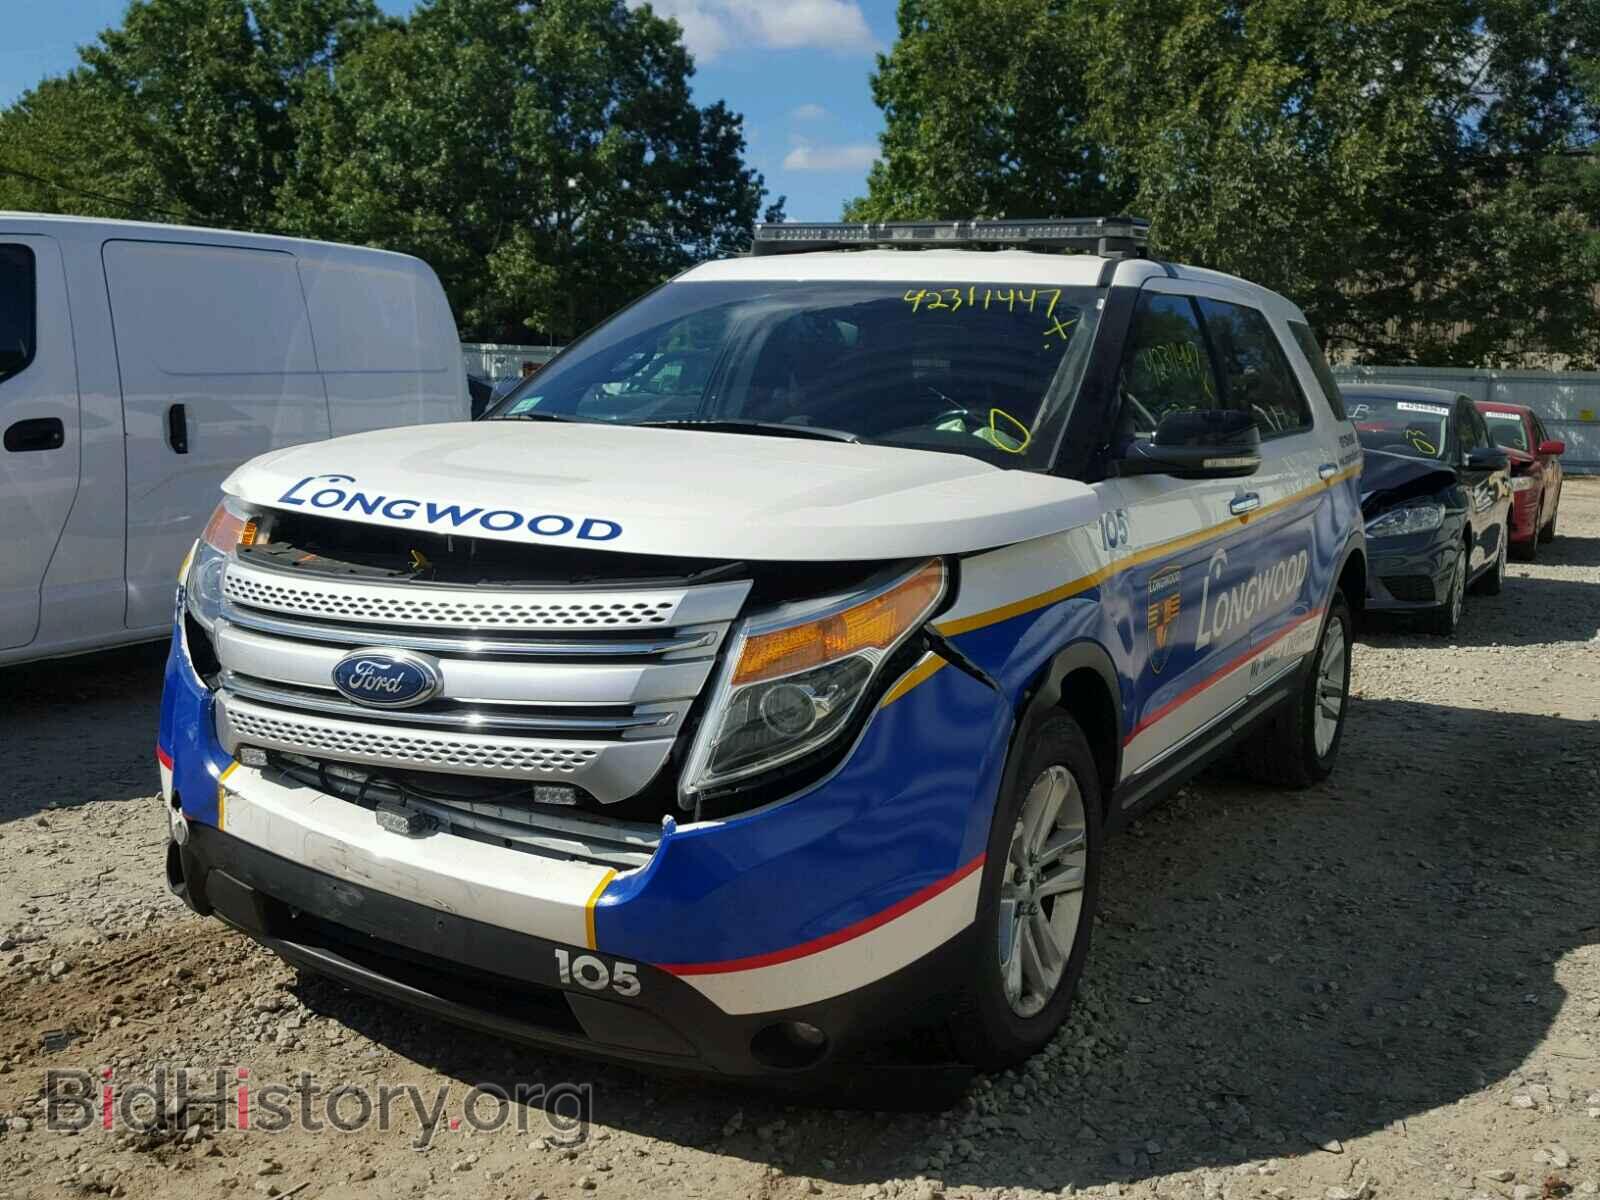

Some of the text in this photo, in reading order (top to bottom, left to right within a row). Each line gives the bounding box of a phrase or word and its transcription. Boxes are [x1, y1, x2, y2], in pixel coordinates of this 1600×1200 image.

[904, 286, 1061, 318] 42311447
[277, 474, 624, 541] LONGWOOD
[1099, 509, 1129, 551] 105
[1195, 548, 1308, 652] LONGWOOD
[348, 660, 405, 693] Ford
[554, 948, 641, 997] 105
